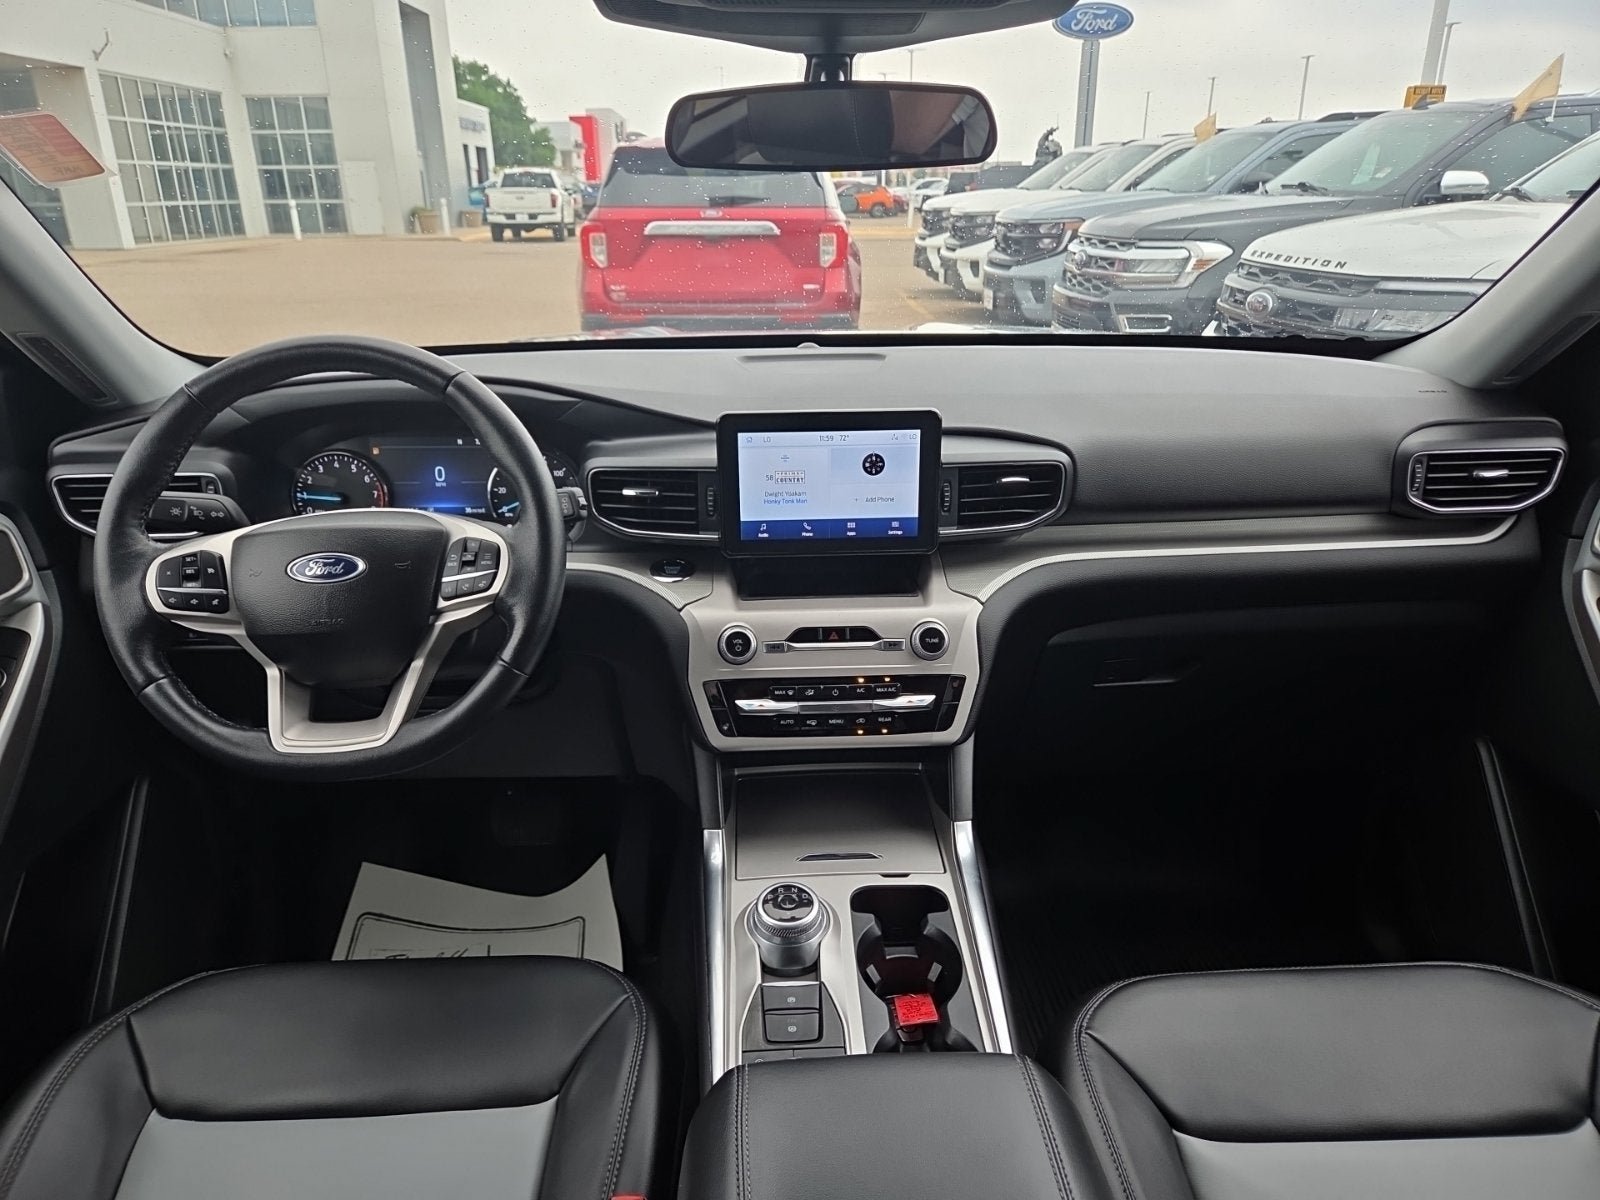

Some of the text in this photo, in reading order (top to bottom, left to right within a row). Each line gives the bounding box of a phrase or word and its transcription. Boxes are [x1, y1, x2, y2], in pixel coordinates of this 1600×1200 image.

[1071, 8, 1118, 31] Ford
[1250, 250, 1348, 269] EXPEDITION
[318, 464, 324, 473] 3
[351, 464, 357, 473] 5
[434, 465, 446, 482] 0
[307, 476, 313, 484] 2
[364, 475, 370, 483] 6
[372, 490, 378, 498] 7
[764, 490, 784, 498] Dwight
[763, 498, 781, 506] Honky
[307, 506, 313, 514] 0
[304, 558, 345, 576] Ford
